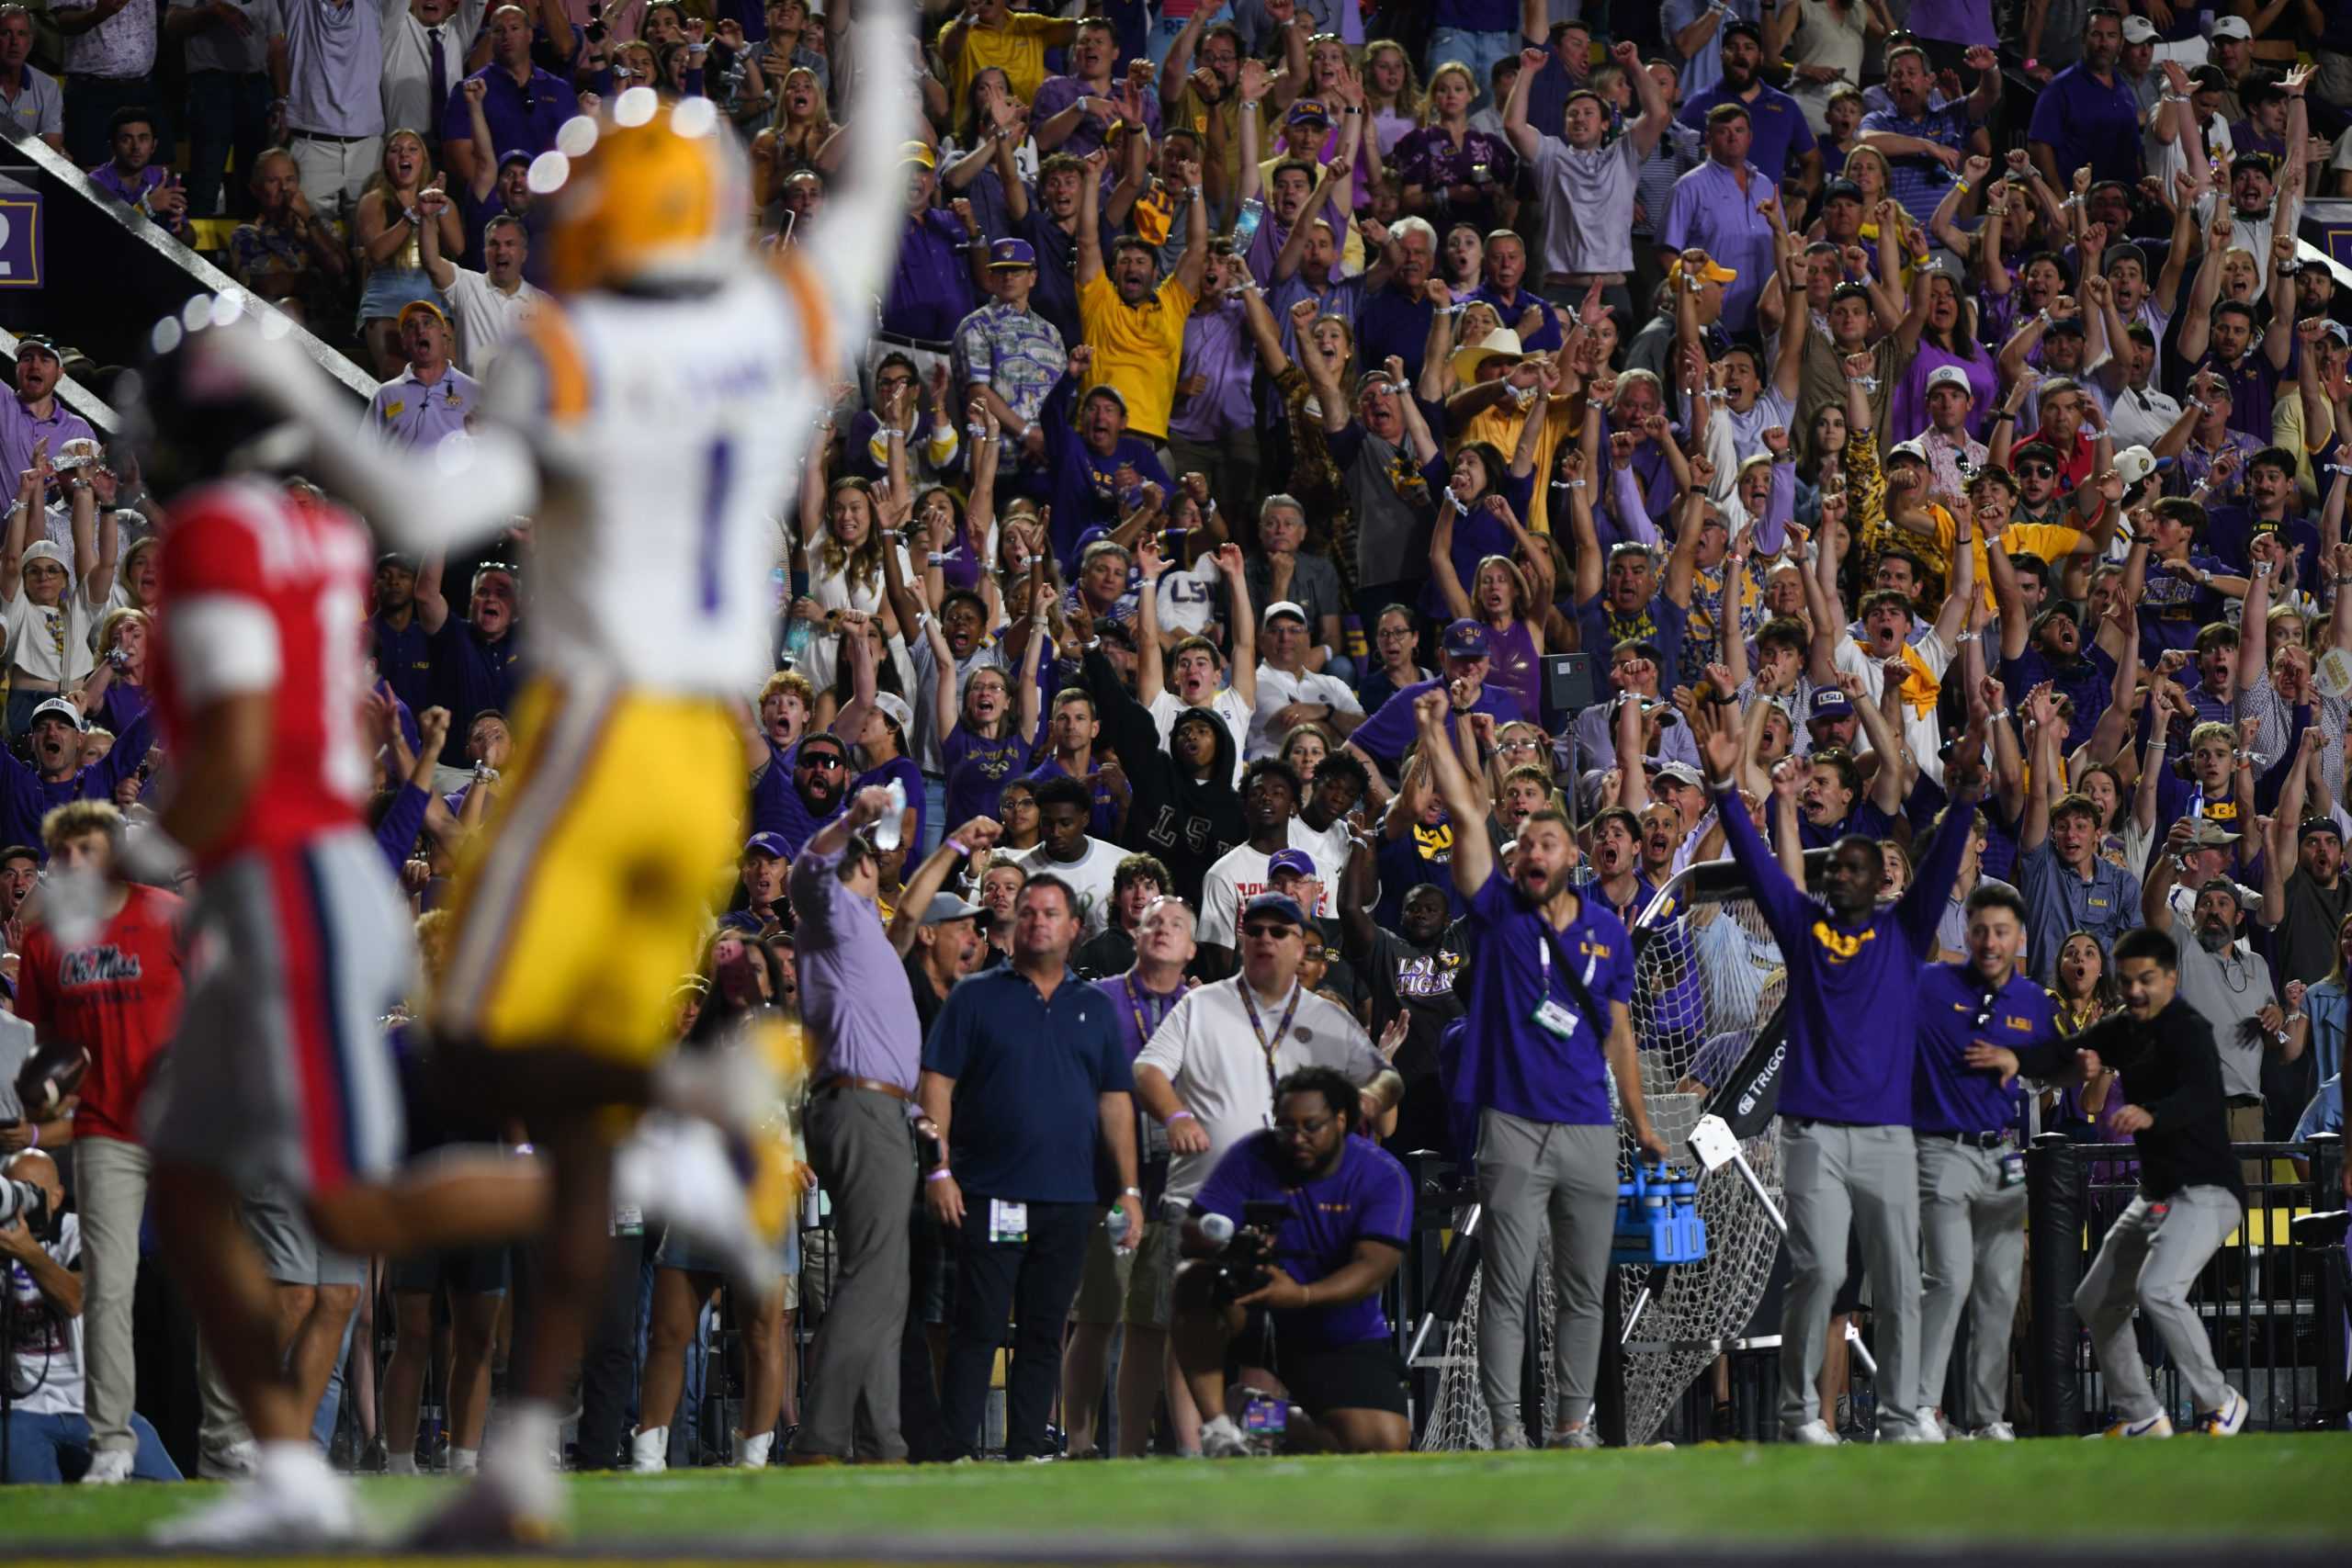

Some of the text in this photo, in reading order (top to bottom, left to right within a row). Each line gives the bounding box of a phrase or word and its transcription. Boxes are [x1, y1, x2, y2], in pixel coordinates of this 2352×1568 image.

[1299, 103, 1324, 114] LSU
[1456, 626, 1481, 637] LSU
[412, 661, 430, 670] LSU
[42, 699, 65, 709] TIGERS
[1414, 823, 1454, 860] LSU
[2087, 897, 2109, 908] LSU
[1579, 941, 1611, 959] LSU
[92, 945, 142, 983] Miss
[1396, 970, 1461, 997] TIGERS
[2006, 1015, 2033, 1032] LSU
[1747, 1038, 1790, 1098] TRIGO
